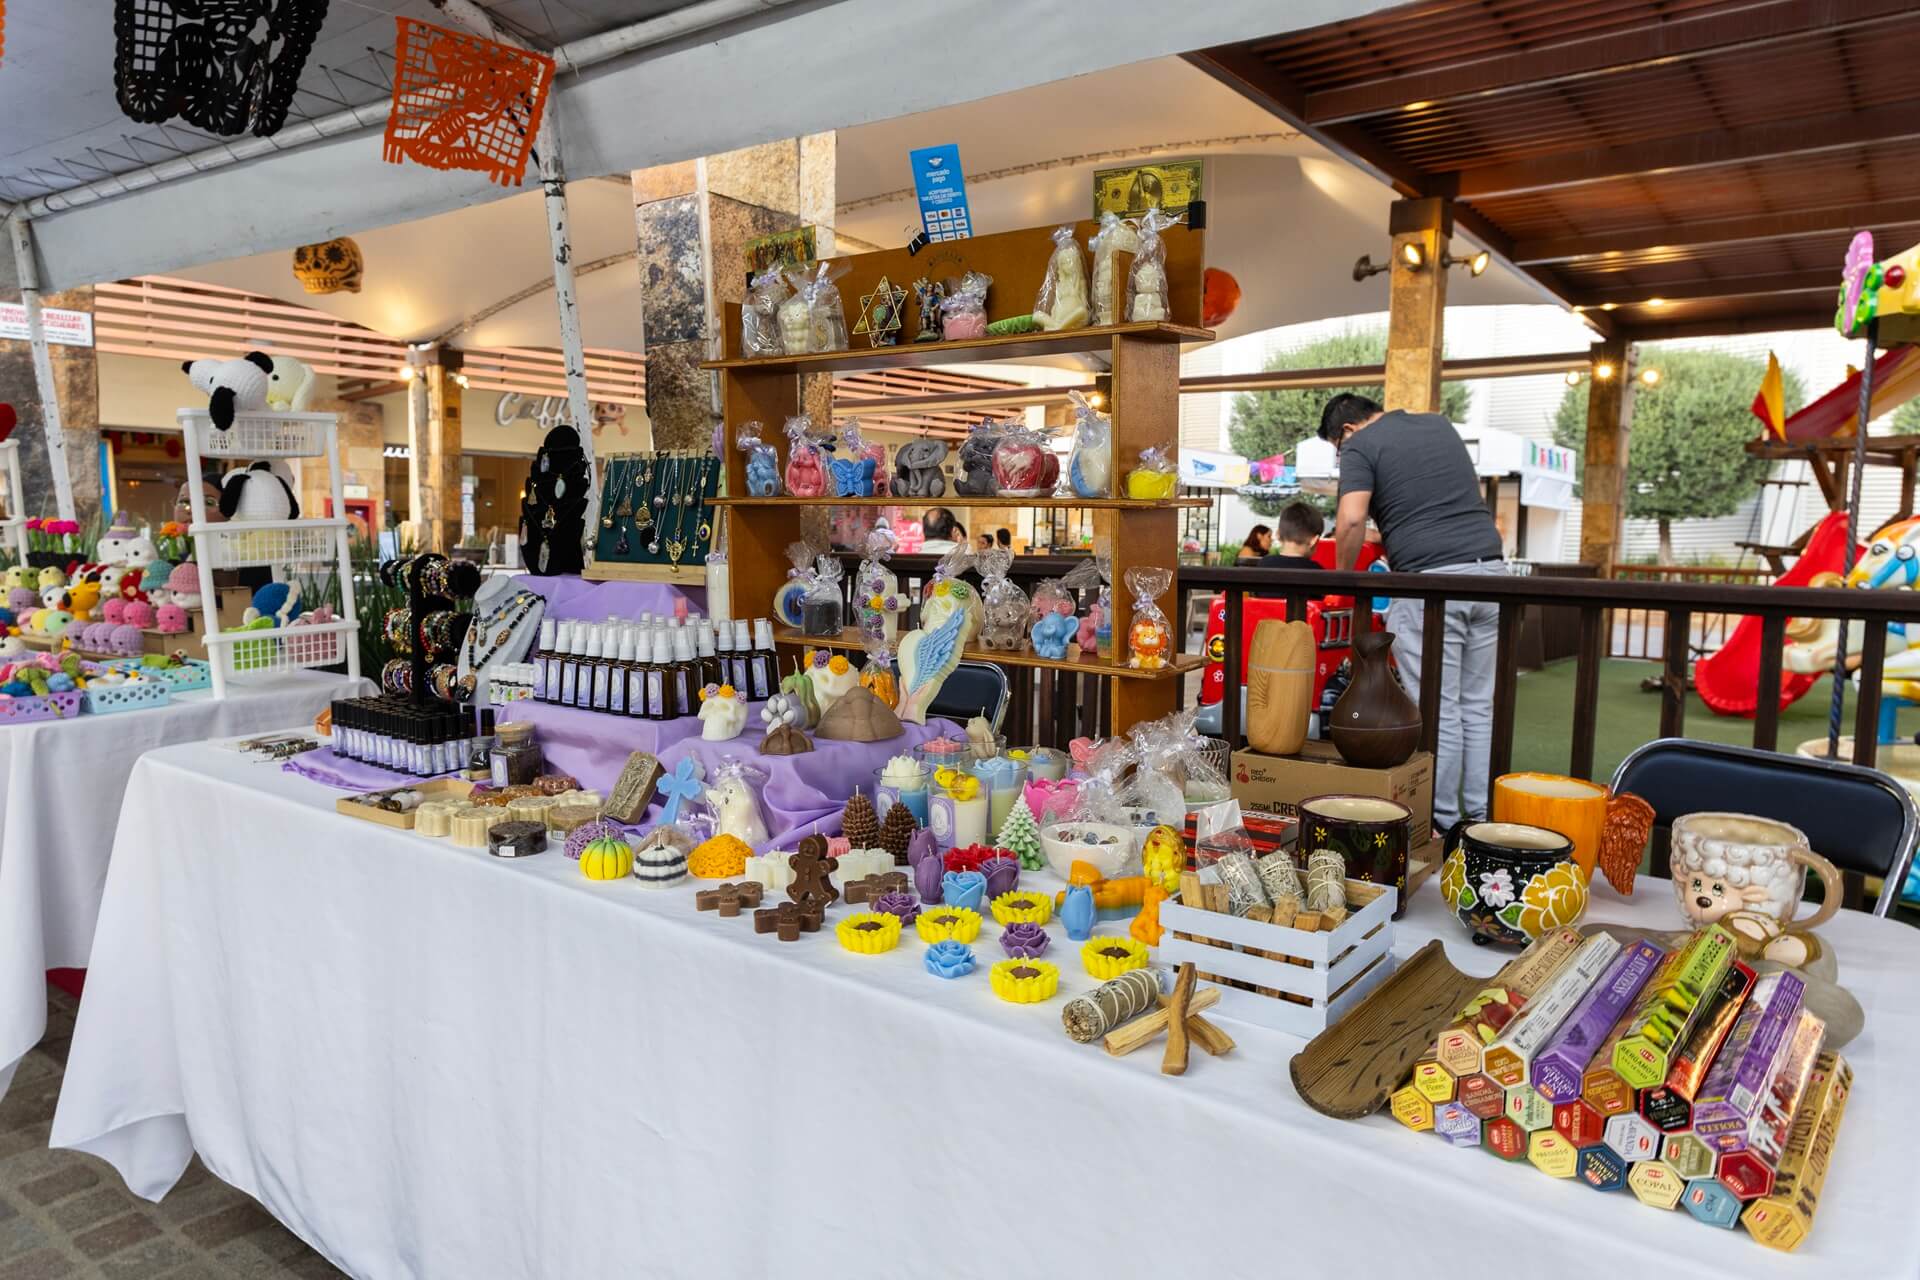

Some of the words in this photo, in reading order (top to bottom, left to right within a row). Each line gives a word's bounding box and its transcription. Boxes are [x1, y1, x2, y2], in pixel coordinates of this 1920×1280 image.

[1250, 775, 1277, 783] CHERRY
[1688, 940, 1722, 984] BERGAMOTA
[1620, 1045, 1660, 1080] BERGAMOTA
[1698, 1122, 1743, 1132] VIOLETA
[1637, 1178, 1674, 1191] COPAL
